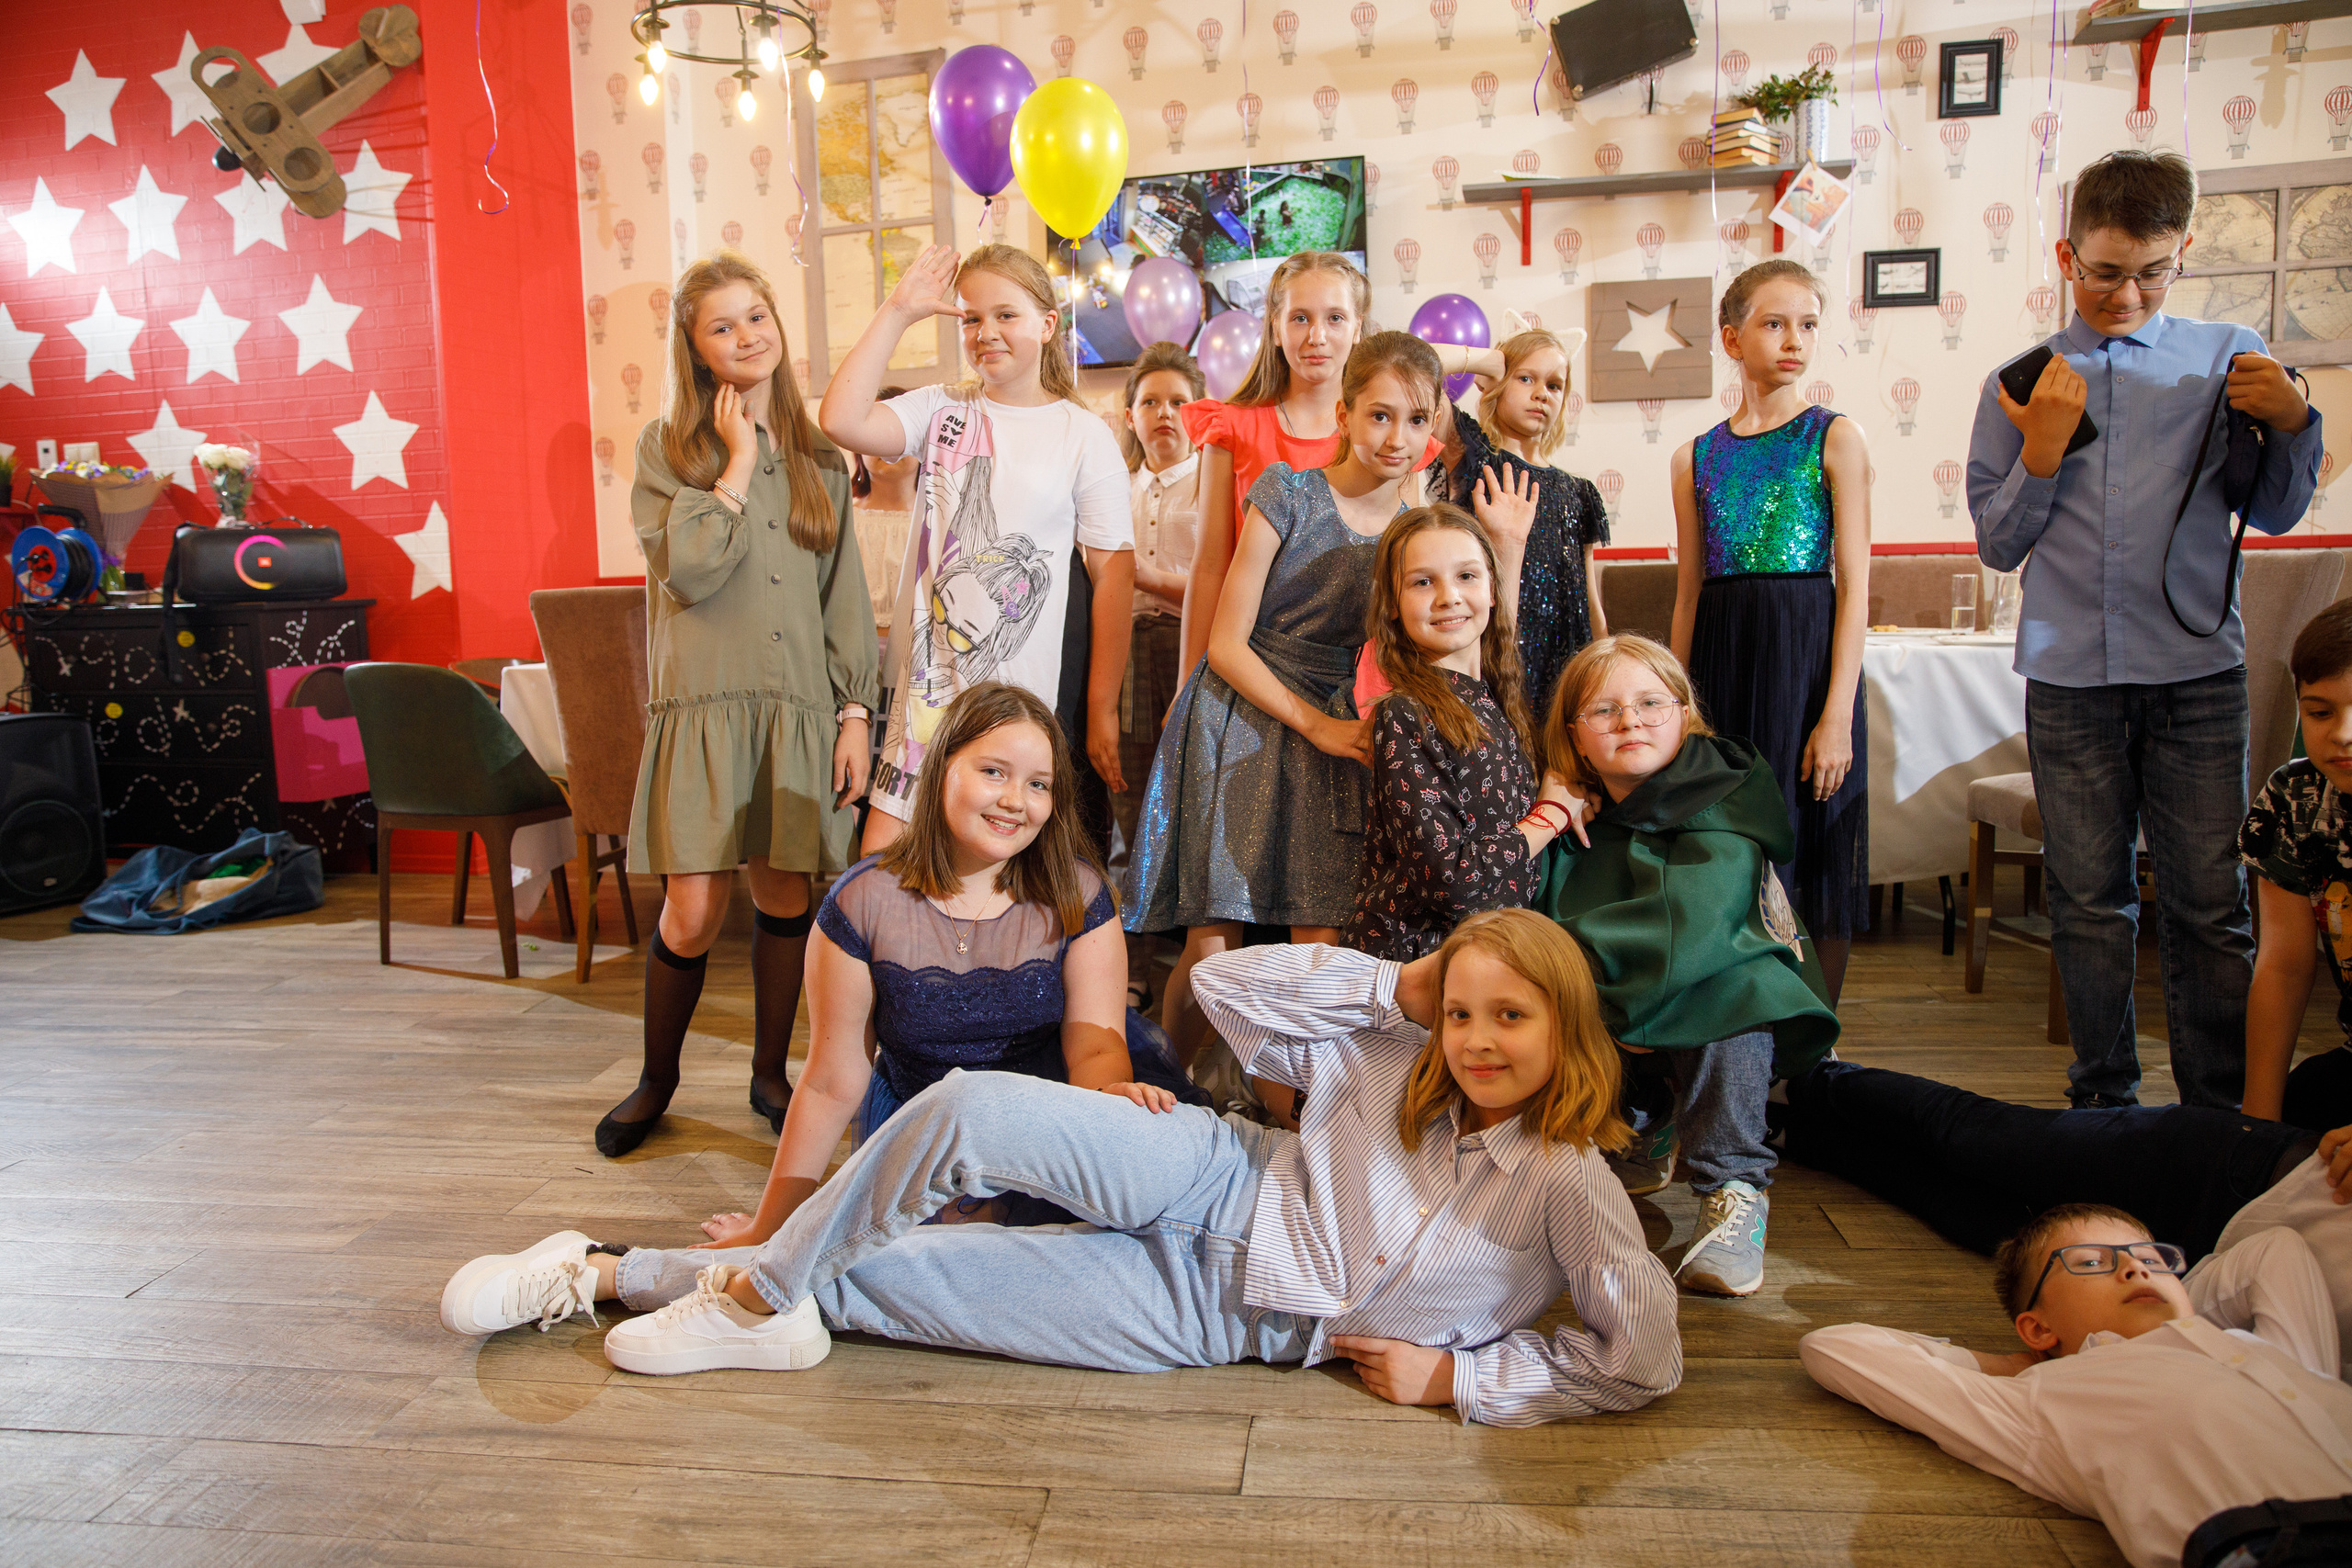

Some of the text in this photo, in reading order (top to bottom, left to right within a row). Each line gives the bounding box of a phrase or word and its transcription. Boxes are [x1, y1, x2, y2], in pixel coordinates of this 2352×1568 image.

[945, 414, 967, 429] AVE
[937, 434, 956, 447] ME
[976, 555, 1005, 563] TRICK
[1009, 604, 1018, 615] OR
